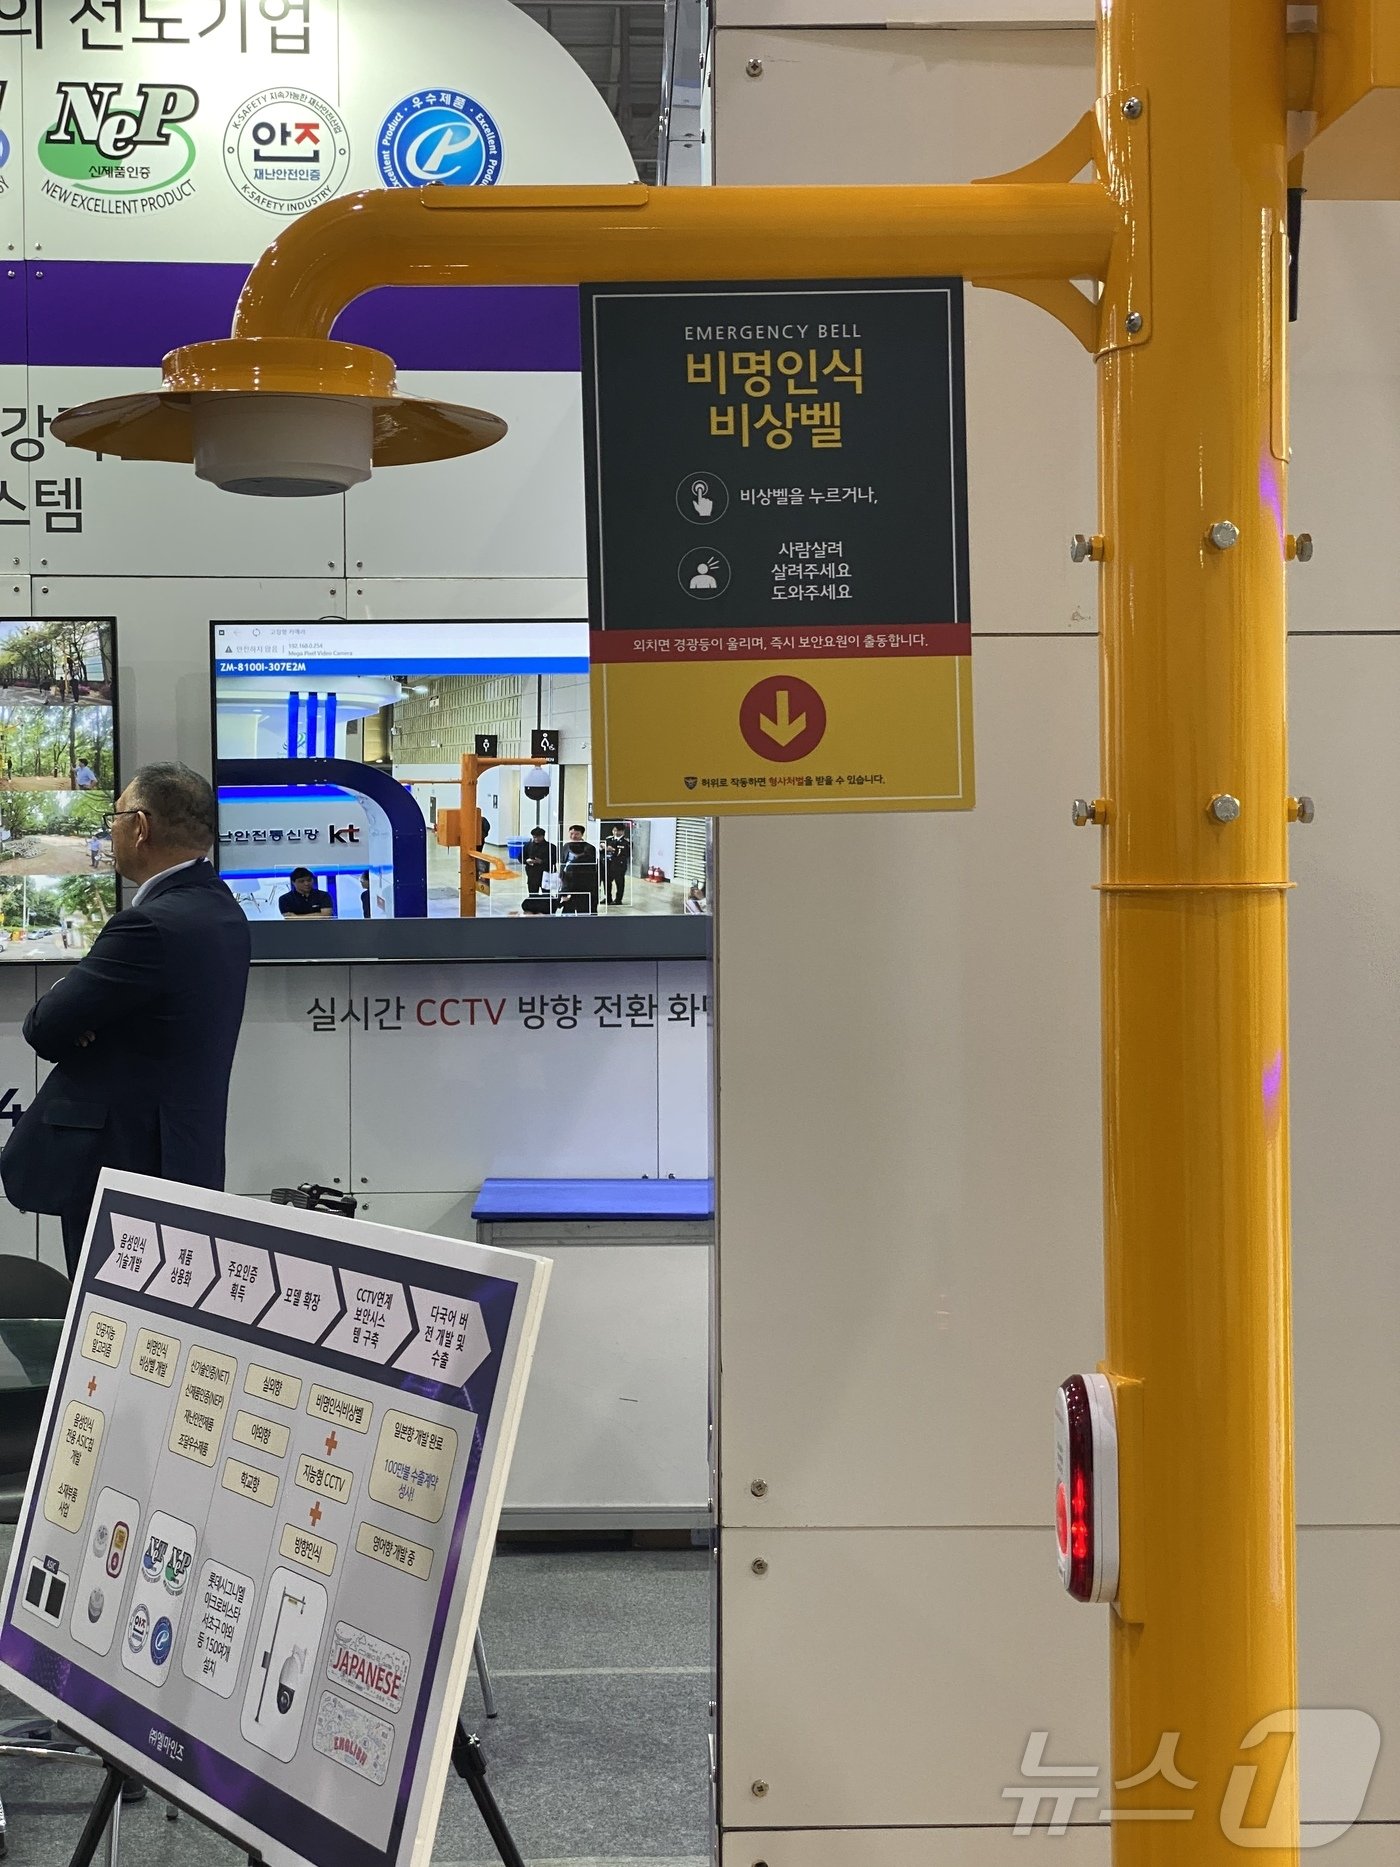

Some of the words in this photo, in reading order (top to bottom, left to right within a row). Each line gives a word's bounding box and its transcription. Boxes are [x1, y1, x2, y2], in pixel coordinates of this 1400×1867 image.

[232, 95, 267, 129] K-SAFETY
[270, 91, 308, 103] 지속가능한
[412, 92, 466, 109] 우수제품
[382, 112, 404, 146] Product
[475, 112, 497, 155] Excellent
[89, 166, 151, 179] 신제품인증
[254, 168, 320, 181] 재난안전인증
[382, 150, 402, 187] xcellent
[41, 179, 68, 203] NEW
[71, 193, 138, 214] EXCELLENT
[141, 178, 196, 212] PRODUCT
[241, 184, 285, 211] K-SAFETY
[287, 185, 332, 212] INDUSTRY
[685, 324, 809, 341] EMERGENCY
[818, 323, 862, 339] BELL
[687, 348, 863, 398] 비명인식
[710, 401, 843, 450] 비상벨
[740, 488, 805, 506] 비상벨을
[809, 486, 878, 504] 누르거나,
[778, 541, 843, 558] 사람살려
[771, 562, 852, 580] 살려주세요
[771, 584, 853, 600] 도와주세요
[633, 639, 671, 652] 외치면
[674, 638, 723, 651] 경광등이
[726, 637, 767, 651] 울리며,
[770, 636, 795, 650] 즉시
[798, 635, 860, 649] 보안요원이
[863, 634, 929, 648] 출동합니다.
[701, 778, 728, 788] 허위로
[731, 778, 767, 787] 작동하면
[769, 776, 812, 786] 형사처벌을
[815, 776, 833, 786] 받을
[835, 776, 845, 786] 수
[847, 774, 886, 785] 있습니다.
[328, 825, 360, 844] kt
[306, 996, 404, 1032] 실시간
[416, 998, 507, 1027] CCTV
[519, 995, 583, 1029] 방향
[594, 994, 658, 1028] 전환
[668, 993, 708, 1028] 화
[120, 1233, 147, 1255] 음성인식
[115, 1252, 143, 1273] 기술개발
[178, 1248, 194, 1266] 제품
[171, 1267, 193, 1287] 상용화
[228, 1261, 258, 1284] 주요인증
[230, 1282, 246, 1302] 획득
[284, 1288, 303, 1307] 모델
[303, 1291, 321, 1312] 확장
[356, 1288, 393, 1311] CCTV연계
[354, 1306, 386, 1328] 보안시스
[430, 1305, 457, 1325] 다국어
[459, 1313, 469, 1330] 버
[96, 1321, 116, 1341] 인공지능
[353, 1327, 361, 1344] 템
[362, 1330, 379, 1349] 구축
[424, 1325, 434, 1343] 전
[436, 1328, 453, 1348] 개발
[455, 1333, 466, 1352] 및
[91, 1338, 112, 1358] 알고리즘
[146, 1339, 169, 1359] 비명인식
[431, 1349, 449, 1369] 수출
[140, 1355, 155, 1374] 비상벨
[155, 1360, 168, 1378] 개발
[315, 1393, 364, 1424] 비명인식비상벨
[74, 1412, 95, 1433] 음성인식
[251, 1422, 271, 1445] 야외향
[66, 1428, 76, 1445] 전용
[394, 1421, 414, 1442] 일본향
[415, 1428, 430, 1448] 개발
[429, 1432, 444, 1451] 완료
[70, 1450, 82, 1466] 개발
[240, 1471, 260, 1494] 학교향
[303, 1463, 323, 1486] 지능형
[324, 1473, 346, 1493] CCTV
[384, 1458, 410, 1480] 100만불
[410, 1465, 439, 1491] 수출계약
[57, 1482, 78, 1503] 소재부품
[59, 1501, 70, 1518] 사업
[294, 1536, 322, 1562] 방향인식
[372, 1535, 393, 1556] 영어향
[392, 1542, 408, 1564] 개발
[407, 1553, 416, 1567] 중
[208, 1571, 246, 1603] 롯데시그니엘
[204, 1591, 241, 1623] 아크로비스타
[202, 1612, 221, 1634] 서초구
[220, 1623, 235, 1643] 야외
[197, 1631, 205, 1649] 등
[205, 1635, 231, 1663] 150여개
[203, 1658, 217, 1677] 설치
[332, 1647, 402, 1700] JAPANESE
